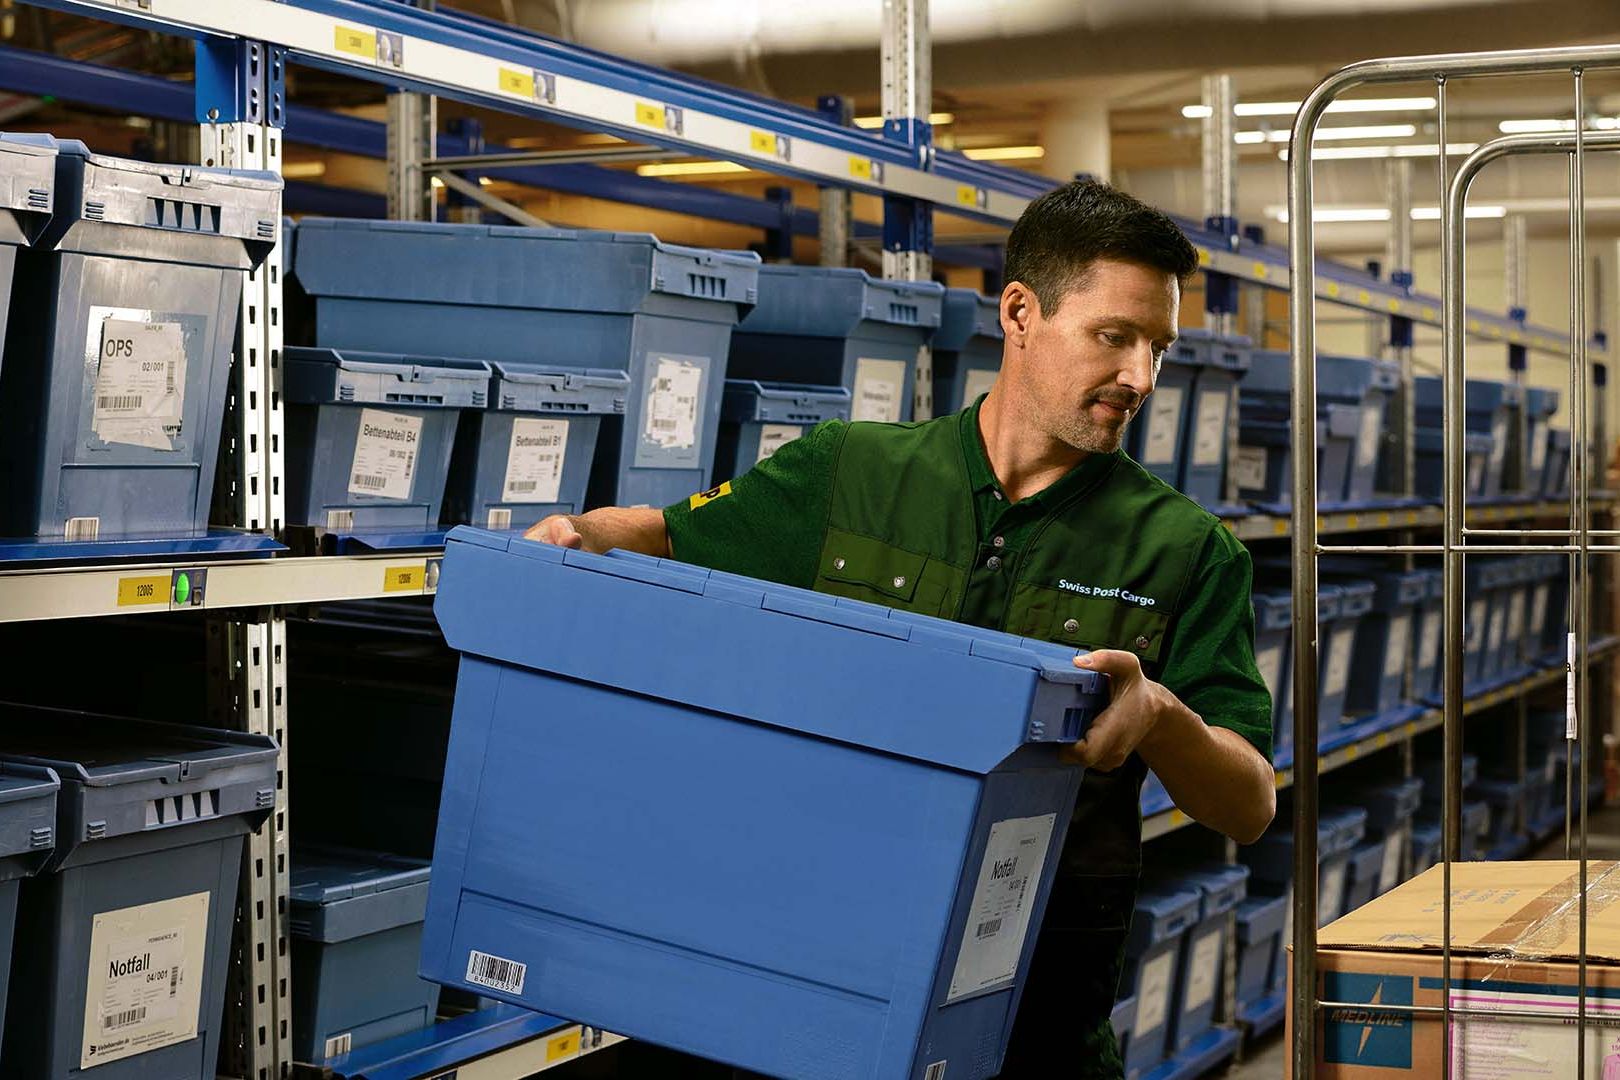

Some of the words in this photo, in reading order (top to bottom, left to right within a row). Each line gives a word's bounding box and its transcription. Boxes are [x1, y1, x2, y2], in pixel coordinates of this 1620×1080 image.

[105, 339, 133, 357] OPS
[142, 362, 164, 372] 02/001
[363, 424, 405, 441] Bettenabteil
[406, 431, 417, 442] B4
[515, 435, 552, 447] Bettenabteil
[136, 584, 153, 597] 12005
[1058, 579, 1091, 594] Swiss
[1093, 586, 1120, 598] Post
[1121, 590, 1155, 606] Cargo
[990, 856, 1018, 881] Notfall
[109, 953, 150, 978] Notfall
[146, 969, 168, 983] 04/001
[474, 975, 515, 992] 84002352
[1331, 1009, 1404, 1026] MEDLINE
